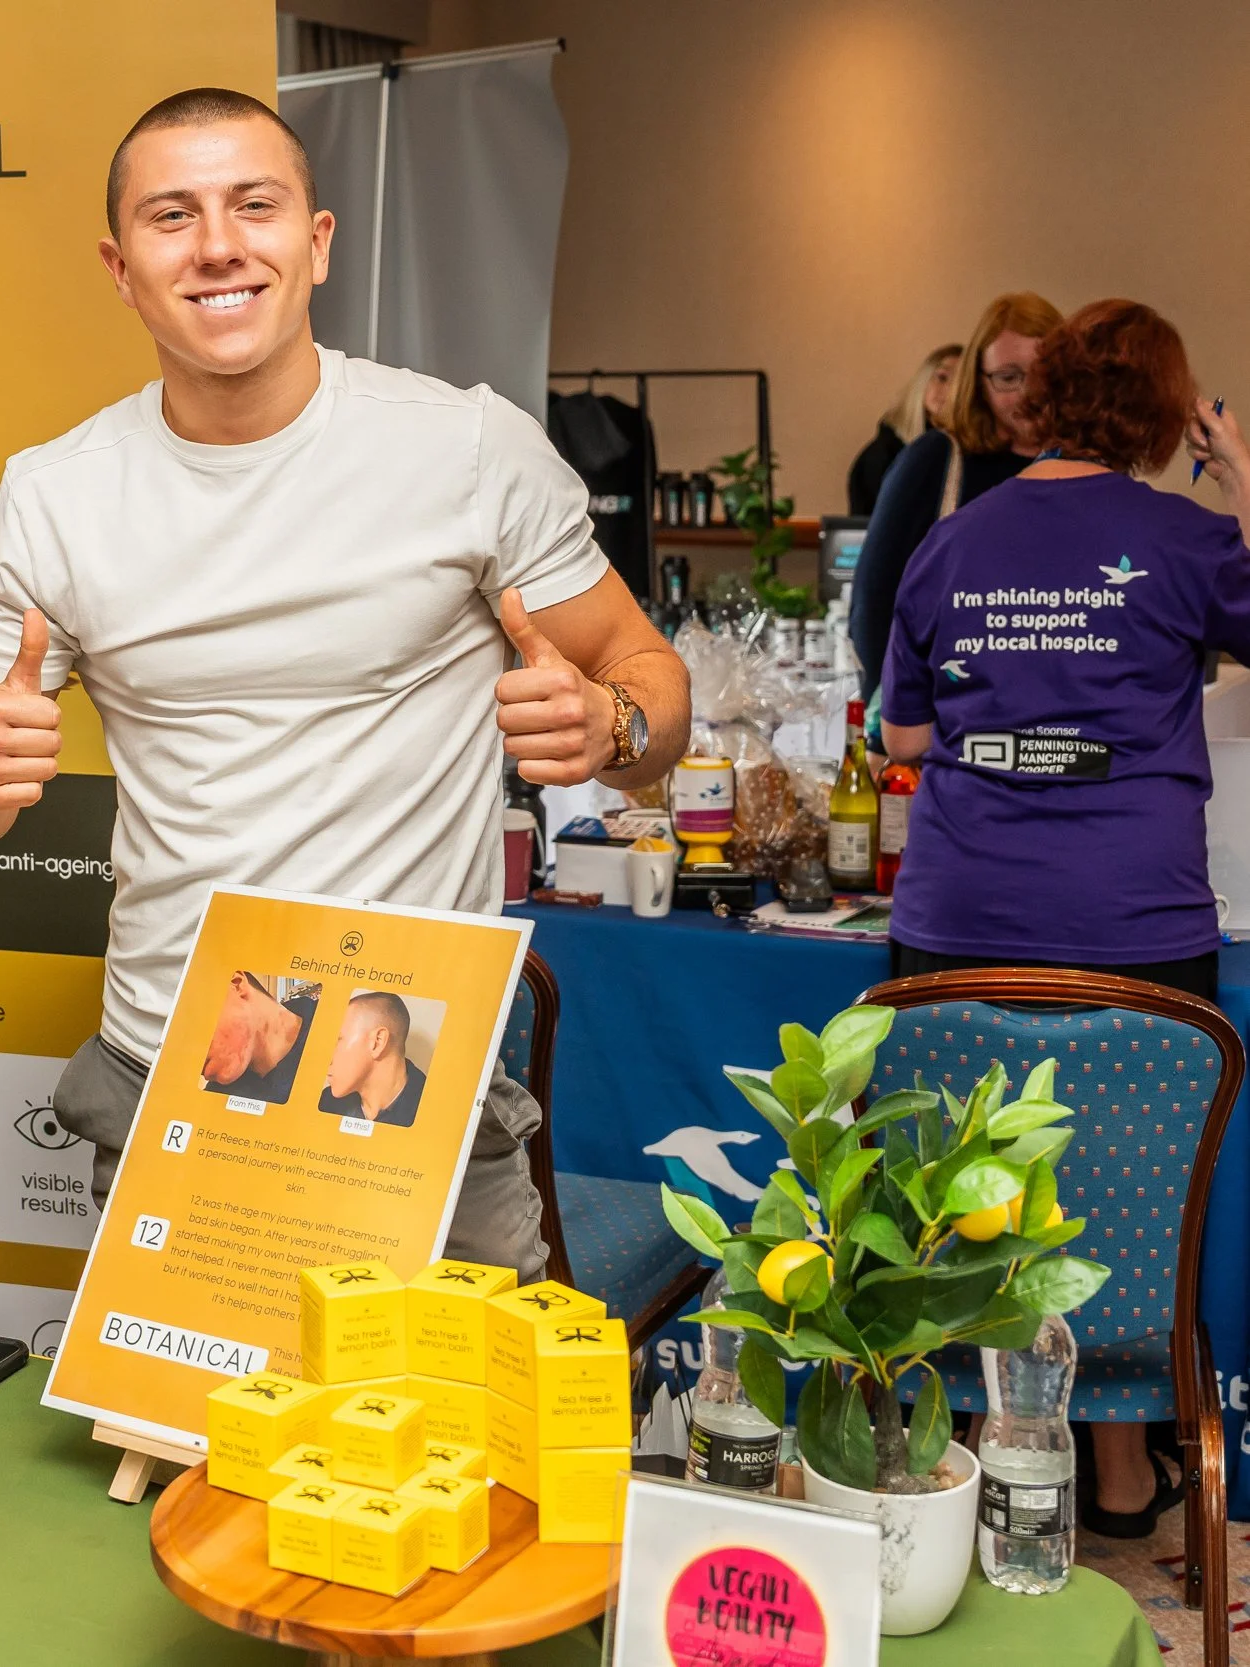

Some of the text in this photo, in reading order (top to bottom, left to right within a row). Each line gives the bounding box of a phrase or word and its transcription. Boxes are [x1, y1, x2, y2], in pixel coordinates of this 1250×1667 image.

[953, 587, 1126, 609] I'm shining bright
[986, 611, 1088, 631] to support
[955, 634, 1118, 654] my local hospice
[1018, 753, 1077, 764] MANCHES
[1020, 739, 1108, 754] PENNINGTONS
[290, 956, 413, 986] Behind the brand
[229, 1098, 246, 1108] from
[167, 1125, 183, 1148] R
[197, 1128, 204, 1138] R
[205, 1129, 218, 1140] for
[220, 1132, 251, 1149] Reece,
[254, 1140, 279, 1153] that's
[281, 1145, 300, 1157] me!
[307, 1149, 348, 1166] founded
[349, 1158, 366, 1170] this
[368, 1162, 398, 1176] brand
[399, 1168, 425, 1181] after
[21, 1171, 85, 1194] visible
[198, 1148, 411, 1197] a personal journey with eczema and troubled
[21, 1194, 88, 1217] results
[139, 1219, 163, 1246] 12
[188, 1212, 209, 1225] bad
[209, 1218, 228, 1230] skin
[230, 1222, 262, 1237] began.
[264, 1229, 289, 1243] After
[290, 1236, 317, 1249] years
[319, 1241, 330, 1252] of
[190, 1194, 400, 1248] 12 was the age my journey with eczema and
[175, 1229, 210, 1244] started
[210, 1237, 247, 1254] making
[247, 1245, 263, 1257] my
[264, 1248, 285, 1261] own
[286, 1252, 317, 1268] balms
[170, 1245, 190, 1258] that
[191, 1250, 224, 1267] helped.
[231, 1260, 259, 1274] never
[260, 1267, 293, 1282] meant
[163, 1262, 180, 1276] but
[180, 1266, 187, 1276] it
[189, 1269, 224, 1285] worked
[225, 1278, 236, 1288] so
[238, 1280, 257, 1293] well
[259, 1284, 279, 1298] that
[212, 1292, 296, 1321] it's helping others
[105, 1317, 255, 1375] BOTANICAL
[274, 1347, 293, 1361] This
